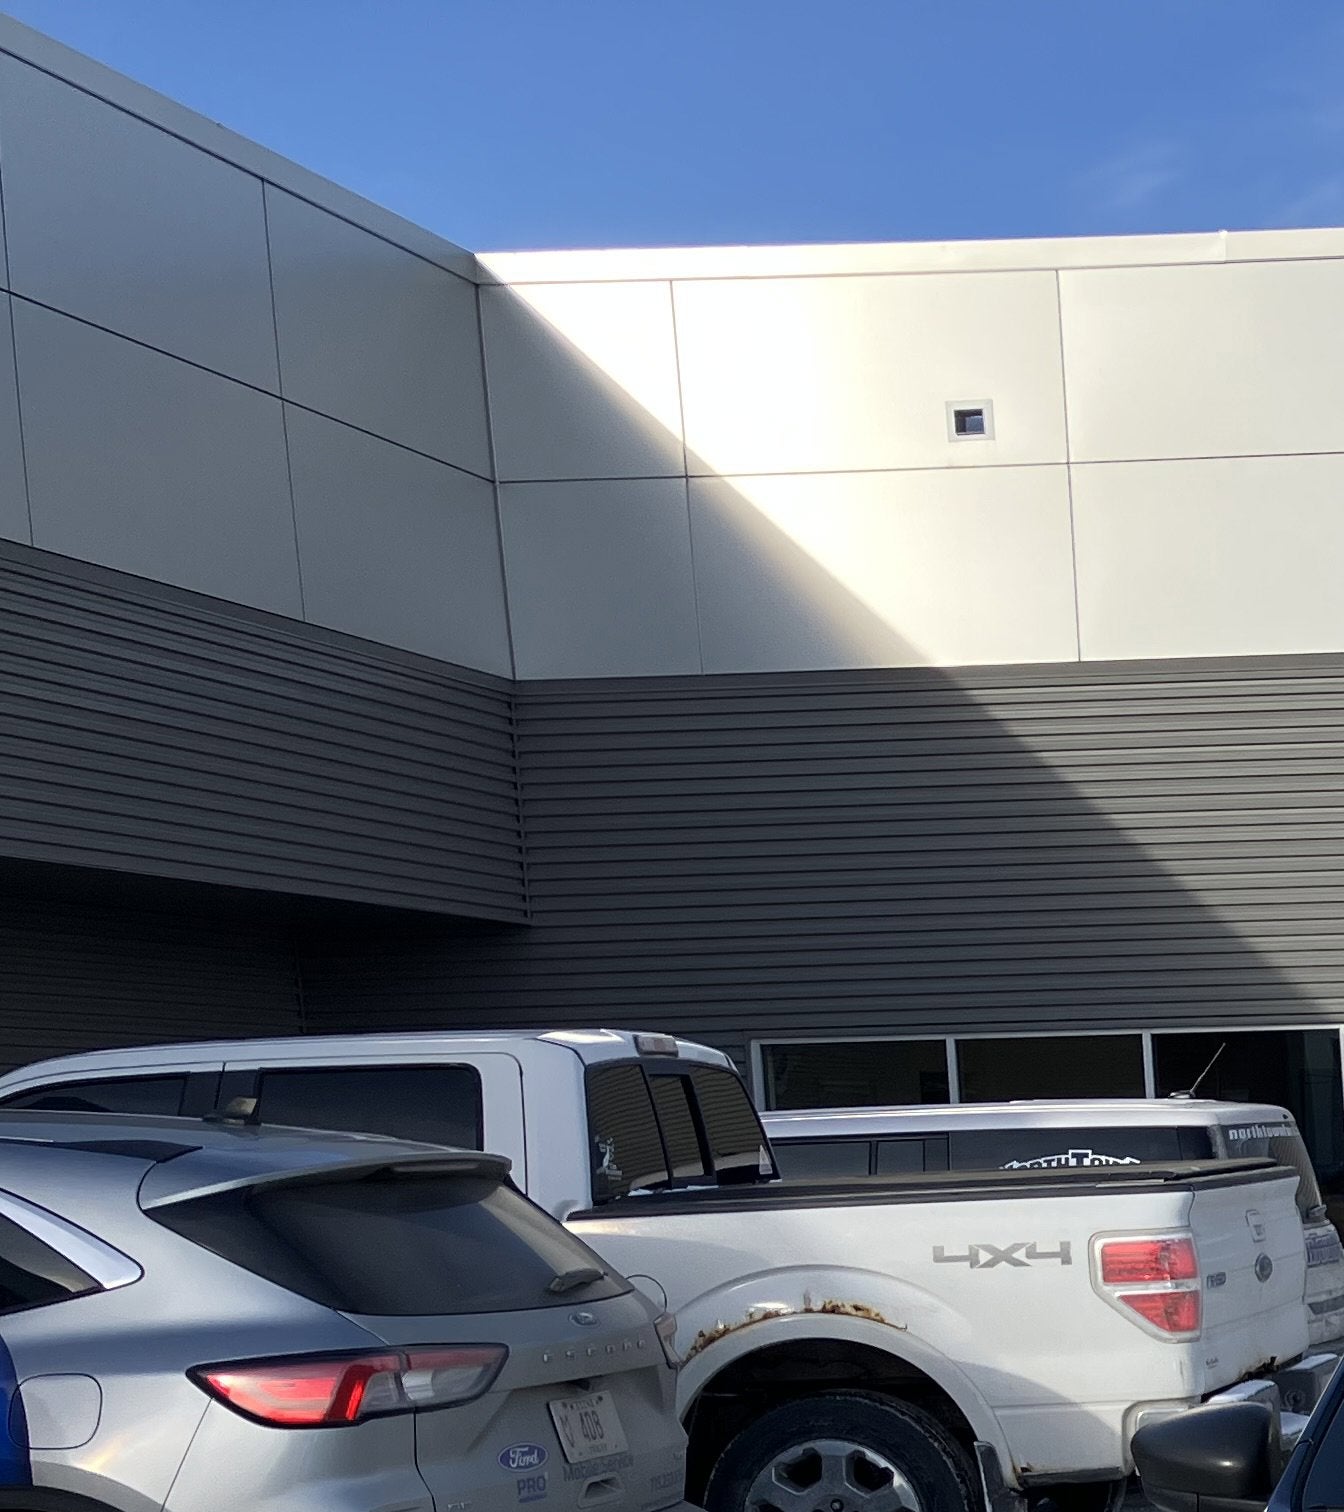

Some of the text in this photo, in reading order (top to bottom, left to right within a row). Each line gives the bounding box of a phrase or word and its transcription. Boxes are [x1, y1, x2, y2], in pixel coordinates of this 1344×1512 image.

[932, 1240, 1073, 1269] 4X4
[509, 1447, 540, 1468] Ford
[516, 1475, 547, 1496] PRO
